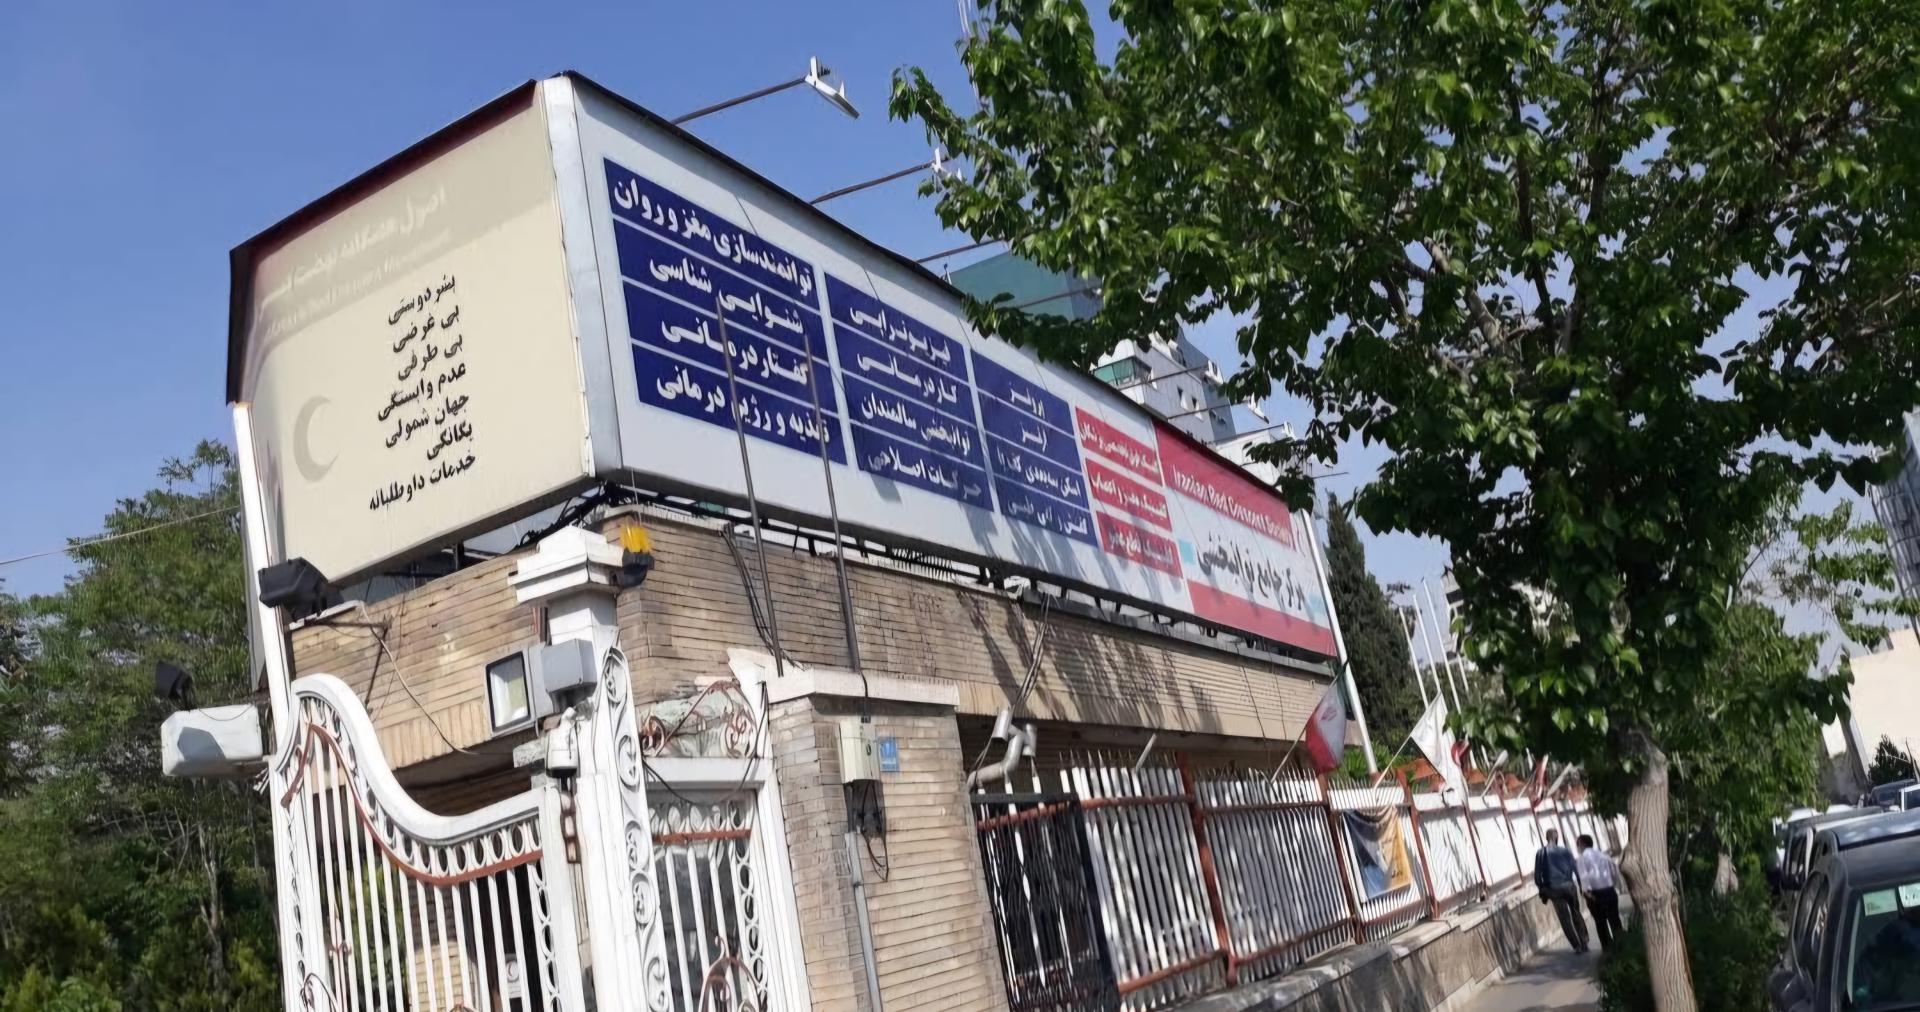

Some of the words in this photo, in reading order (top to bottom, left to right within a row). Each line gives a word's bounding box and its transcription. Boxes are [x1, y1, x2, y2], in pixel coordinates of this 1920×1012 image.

[649, 256, 713, 294] شناسی
[440, 304, 460, 330] بی
[718, 289, 804, 335] شنوایی
[393, 312, 435, 354] غرضی
[444, 333, 463, 359] بی
[398, 343, 438, 382] طرفی
[438, 362, 467, 395] عدم
[378, 377, 434, 422] وابستگی
[656, 364, 727, 414] درمانی
[386, 407, 430, 449] شمولی
[434, 395, 469, 426] جهان
[776, 411, 787, 437] و
[861, 392, 917, 430] سالمندان
[920, 418, 971, 457] توانبخشی
[429, 449, 476, 485] خدمات
[867, 445, 928, 480] اصلاحی
[369, 473, 425, 512] داوطلبانه
